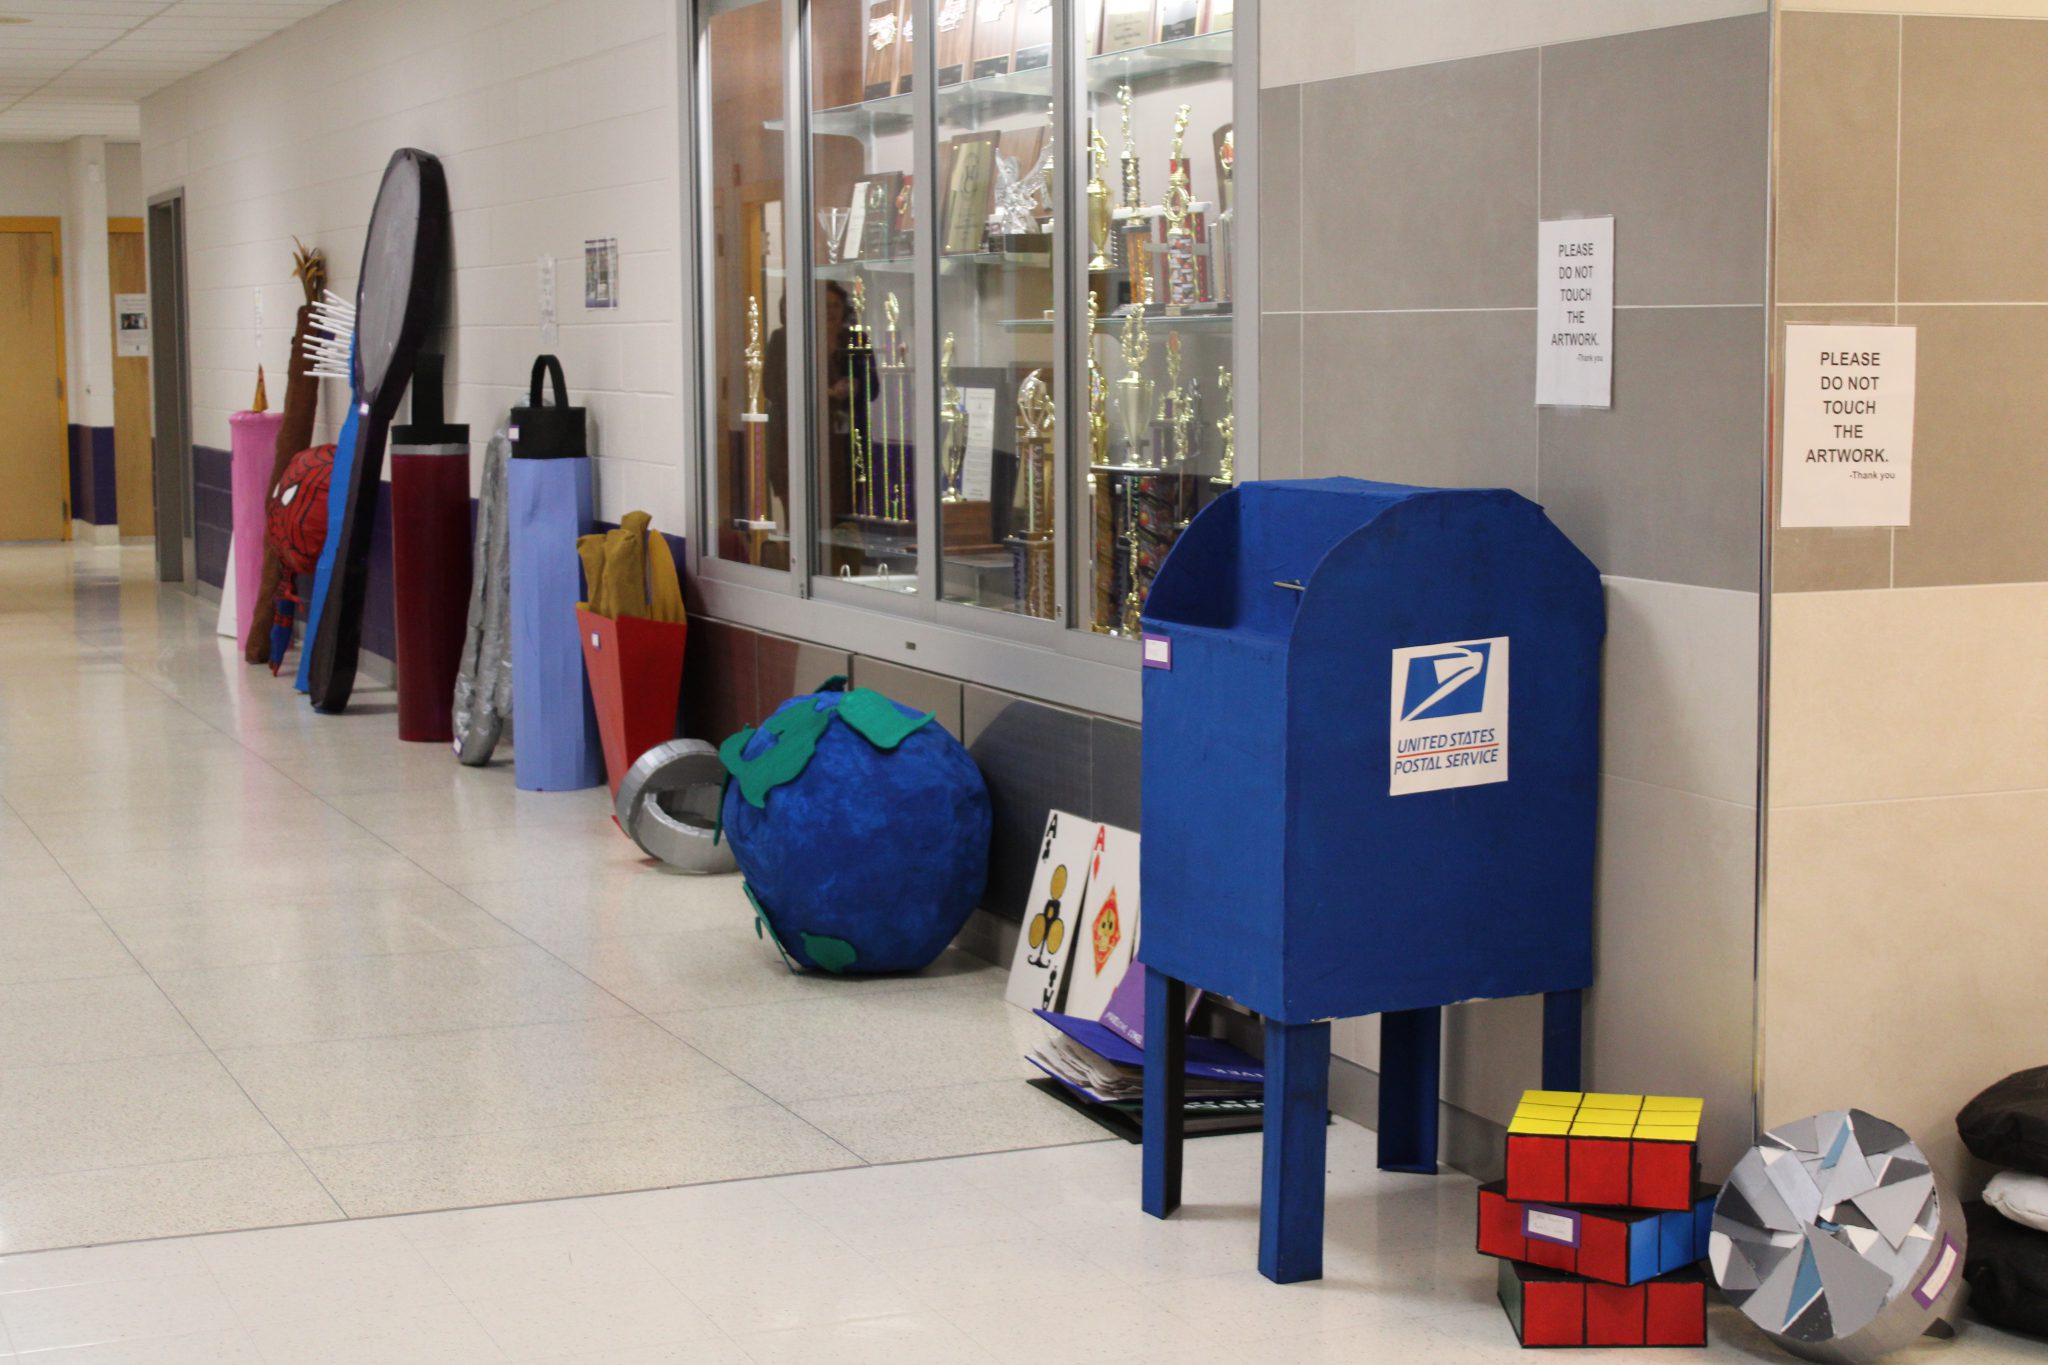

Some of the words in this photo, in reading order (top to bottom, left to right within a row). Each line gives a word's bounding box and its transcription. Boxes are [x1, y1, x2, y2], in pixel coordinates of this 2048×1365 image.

[1558, 243, 1594, 257] PLEASE
[1559, 266, 1572, 279] DO
[1574, 265, 1593, 279] NOT
[1560, 288, 1592, 301] TOUCH
[1566, 311, 1585, 324] THE
[1550, 333, 1599, 346] ARTWORK.
[1820, 351, 1881, 366] PLEASE
[1821, 376, 1843, 390] DO
[1848, 376, 1880, 390] NOT
[1823, 400, 1876, 414] TOUCH
[1833, 424, 1864, 438] THE
[1805, 448, 1889, 463] ARTWORK.
[1849, 470, 1878, 480] -Thank
[1880, 472, 1896, 481] you
[1397, 734, 1448, 754] UNITED
[1450, 728, 1495, 747] STATES
[1393, 757, 1442, 775] POSTAL
[1445, 748, 1499, 769] SERVICE
[1046, 813, 1058, 839] A
[1094, 825, 1105, 852] A
